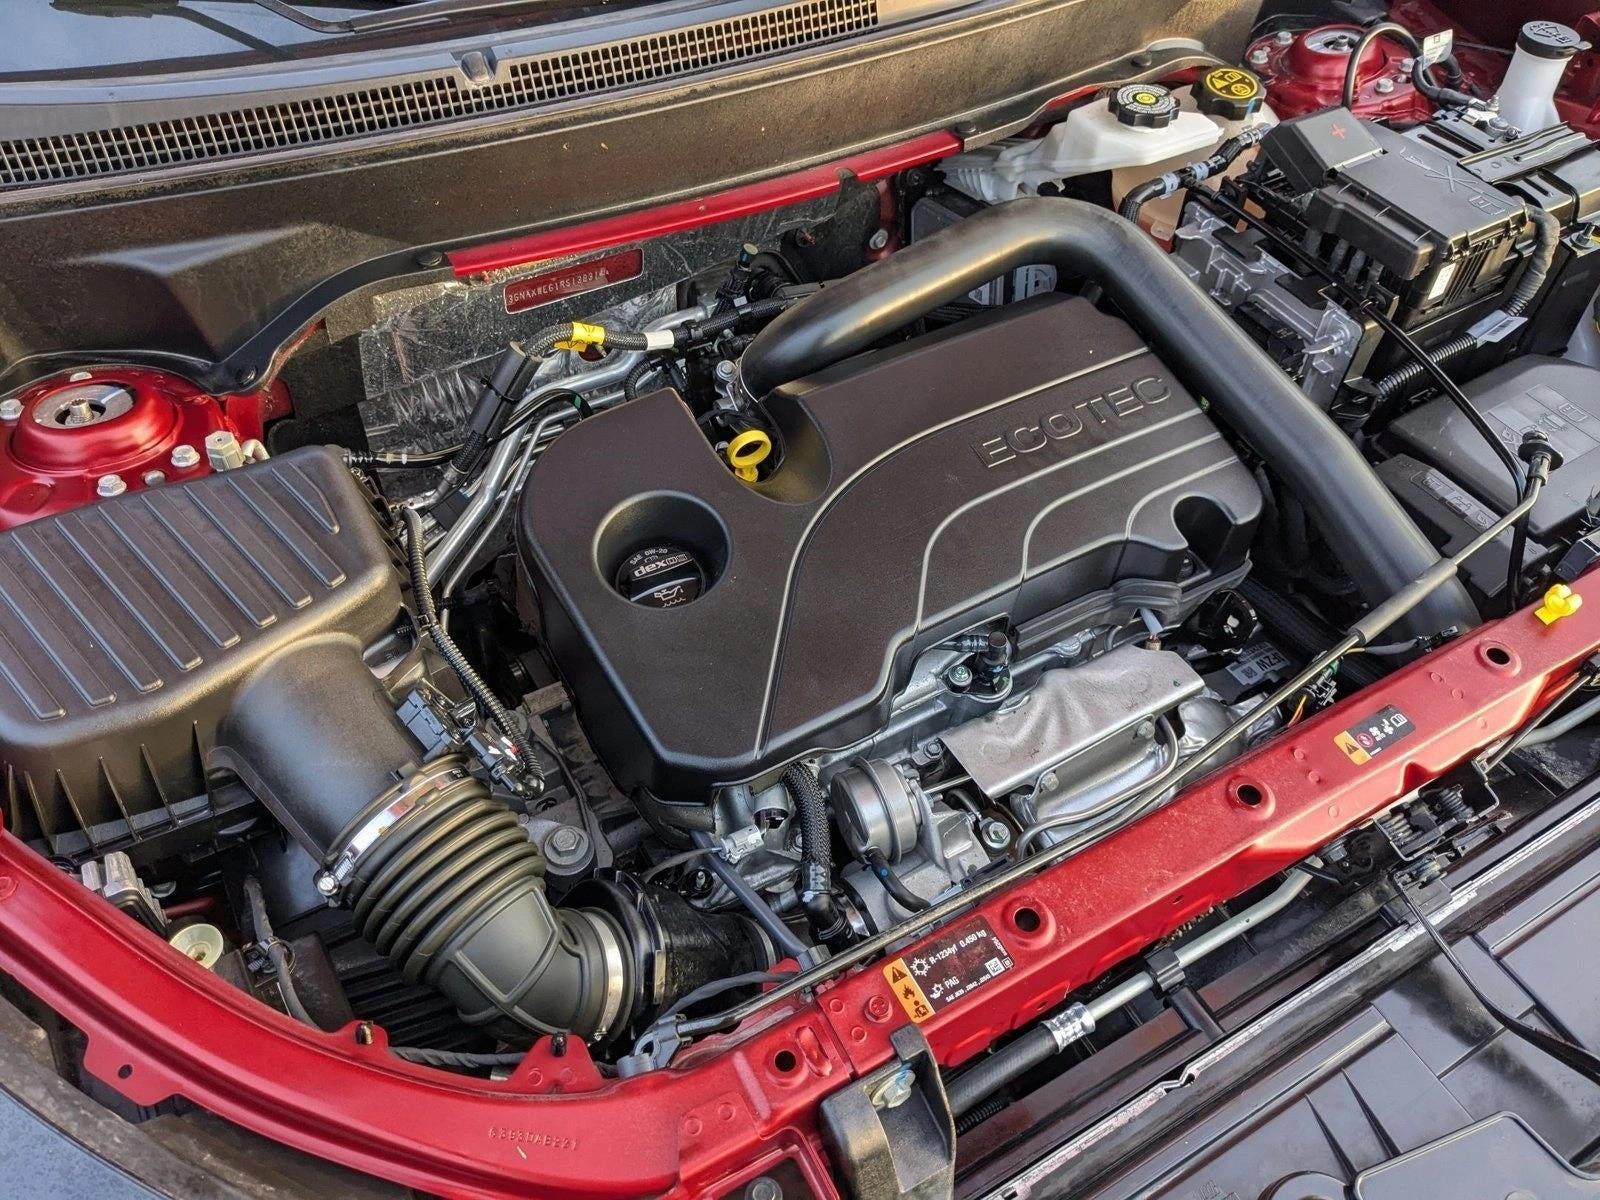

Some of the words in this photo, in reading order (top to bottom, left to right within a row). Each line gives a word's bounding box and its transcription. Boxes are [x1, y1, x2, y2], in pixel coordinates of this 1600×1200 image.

[969, 377, 1171, 468] ECOTEC
[630, 554, 643, 565] SAE
[929, 943, 958, 965] R-1234yf
[960, 933, 977, 947] 0.450
[976, 929, 987, 940] kg
[944, 976, 960, 989] PAG
